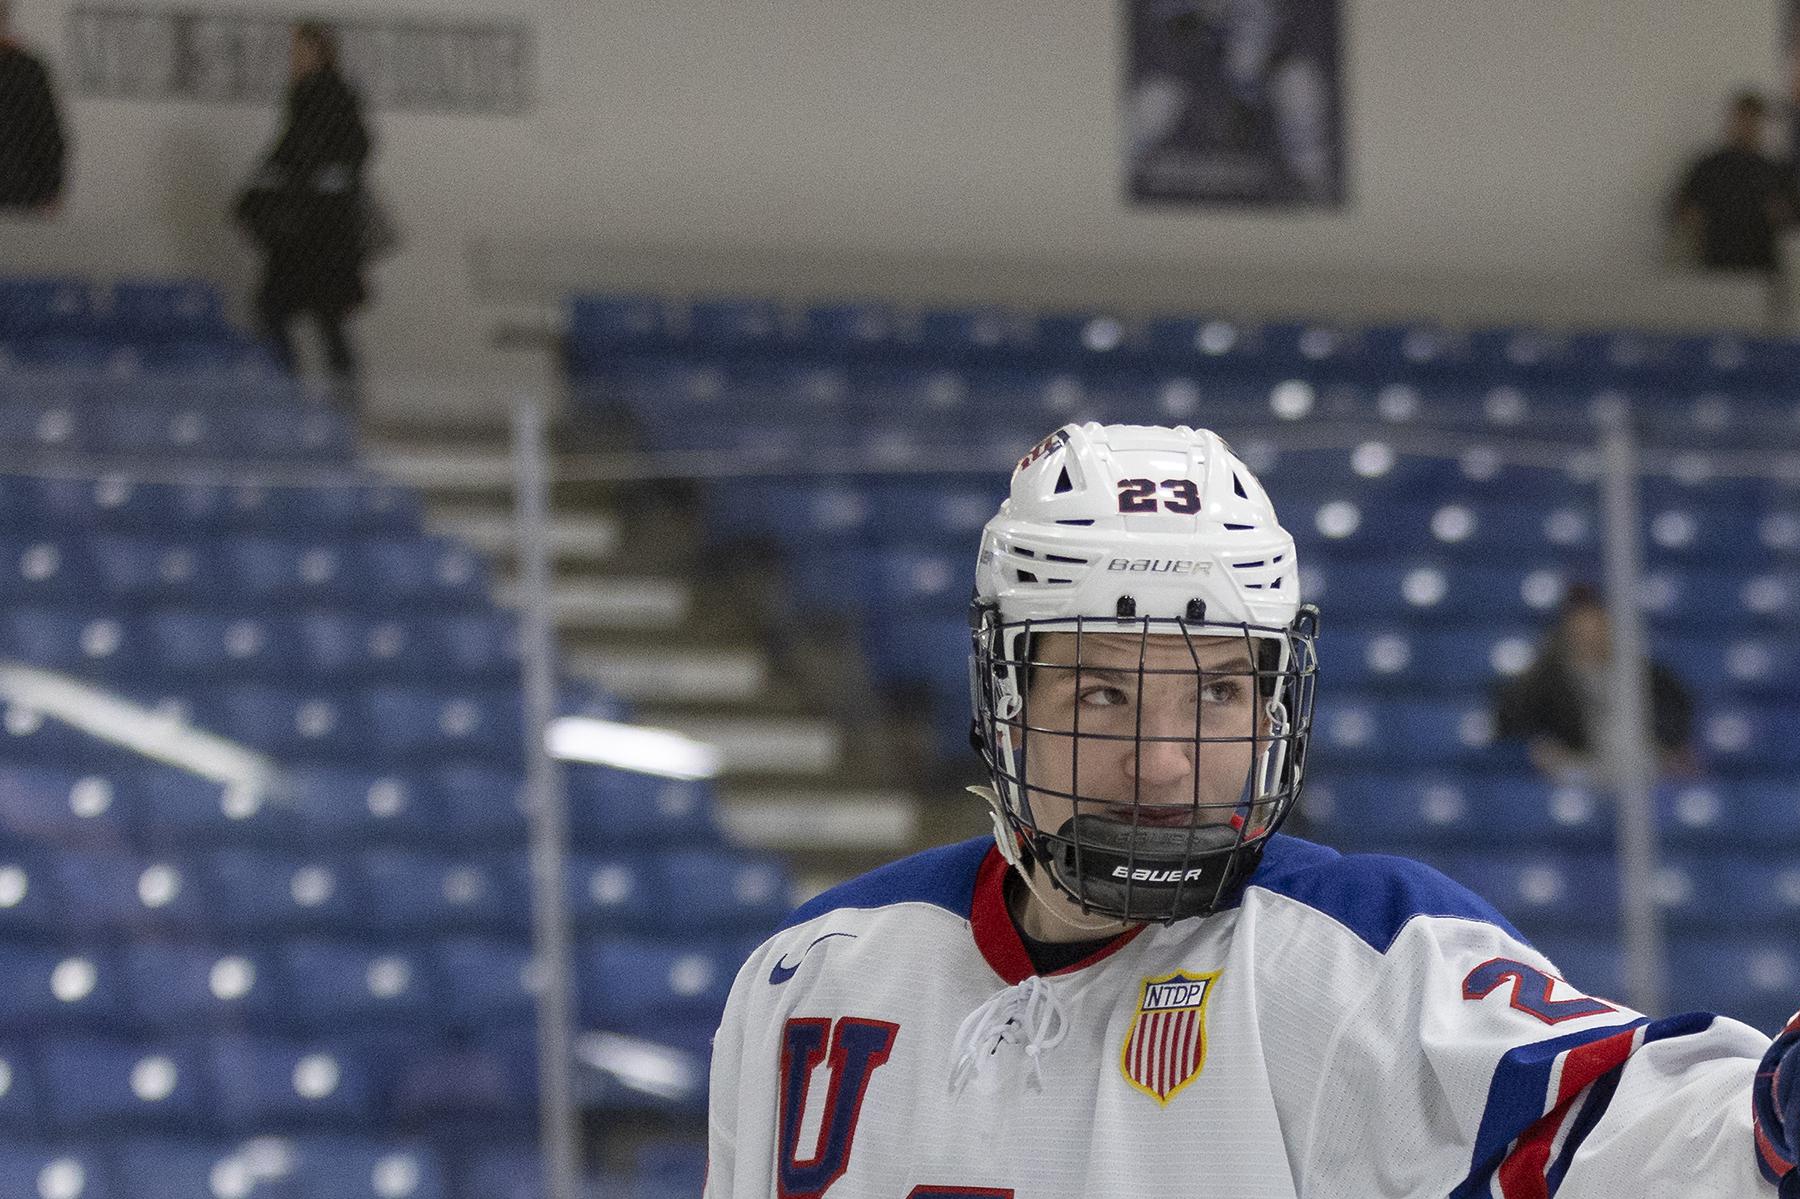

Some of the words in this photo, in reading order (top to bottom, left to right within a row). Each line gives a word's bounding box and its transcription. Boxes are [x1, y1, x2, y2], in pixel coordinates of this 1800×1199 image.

[1116, 479, 1202, 515] 23
[1107, 558, 1213, 575] BAUER
[1111, 866, 1203, 882] BAUER
[1147, 984, 1201, 1007] NTDP
[1461, 957, 1620, 1026] 2
